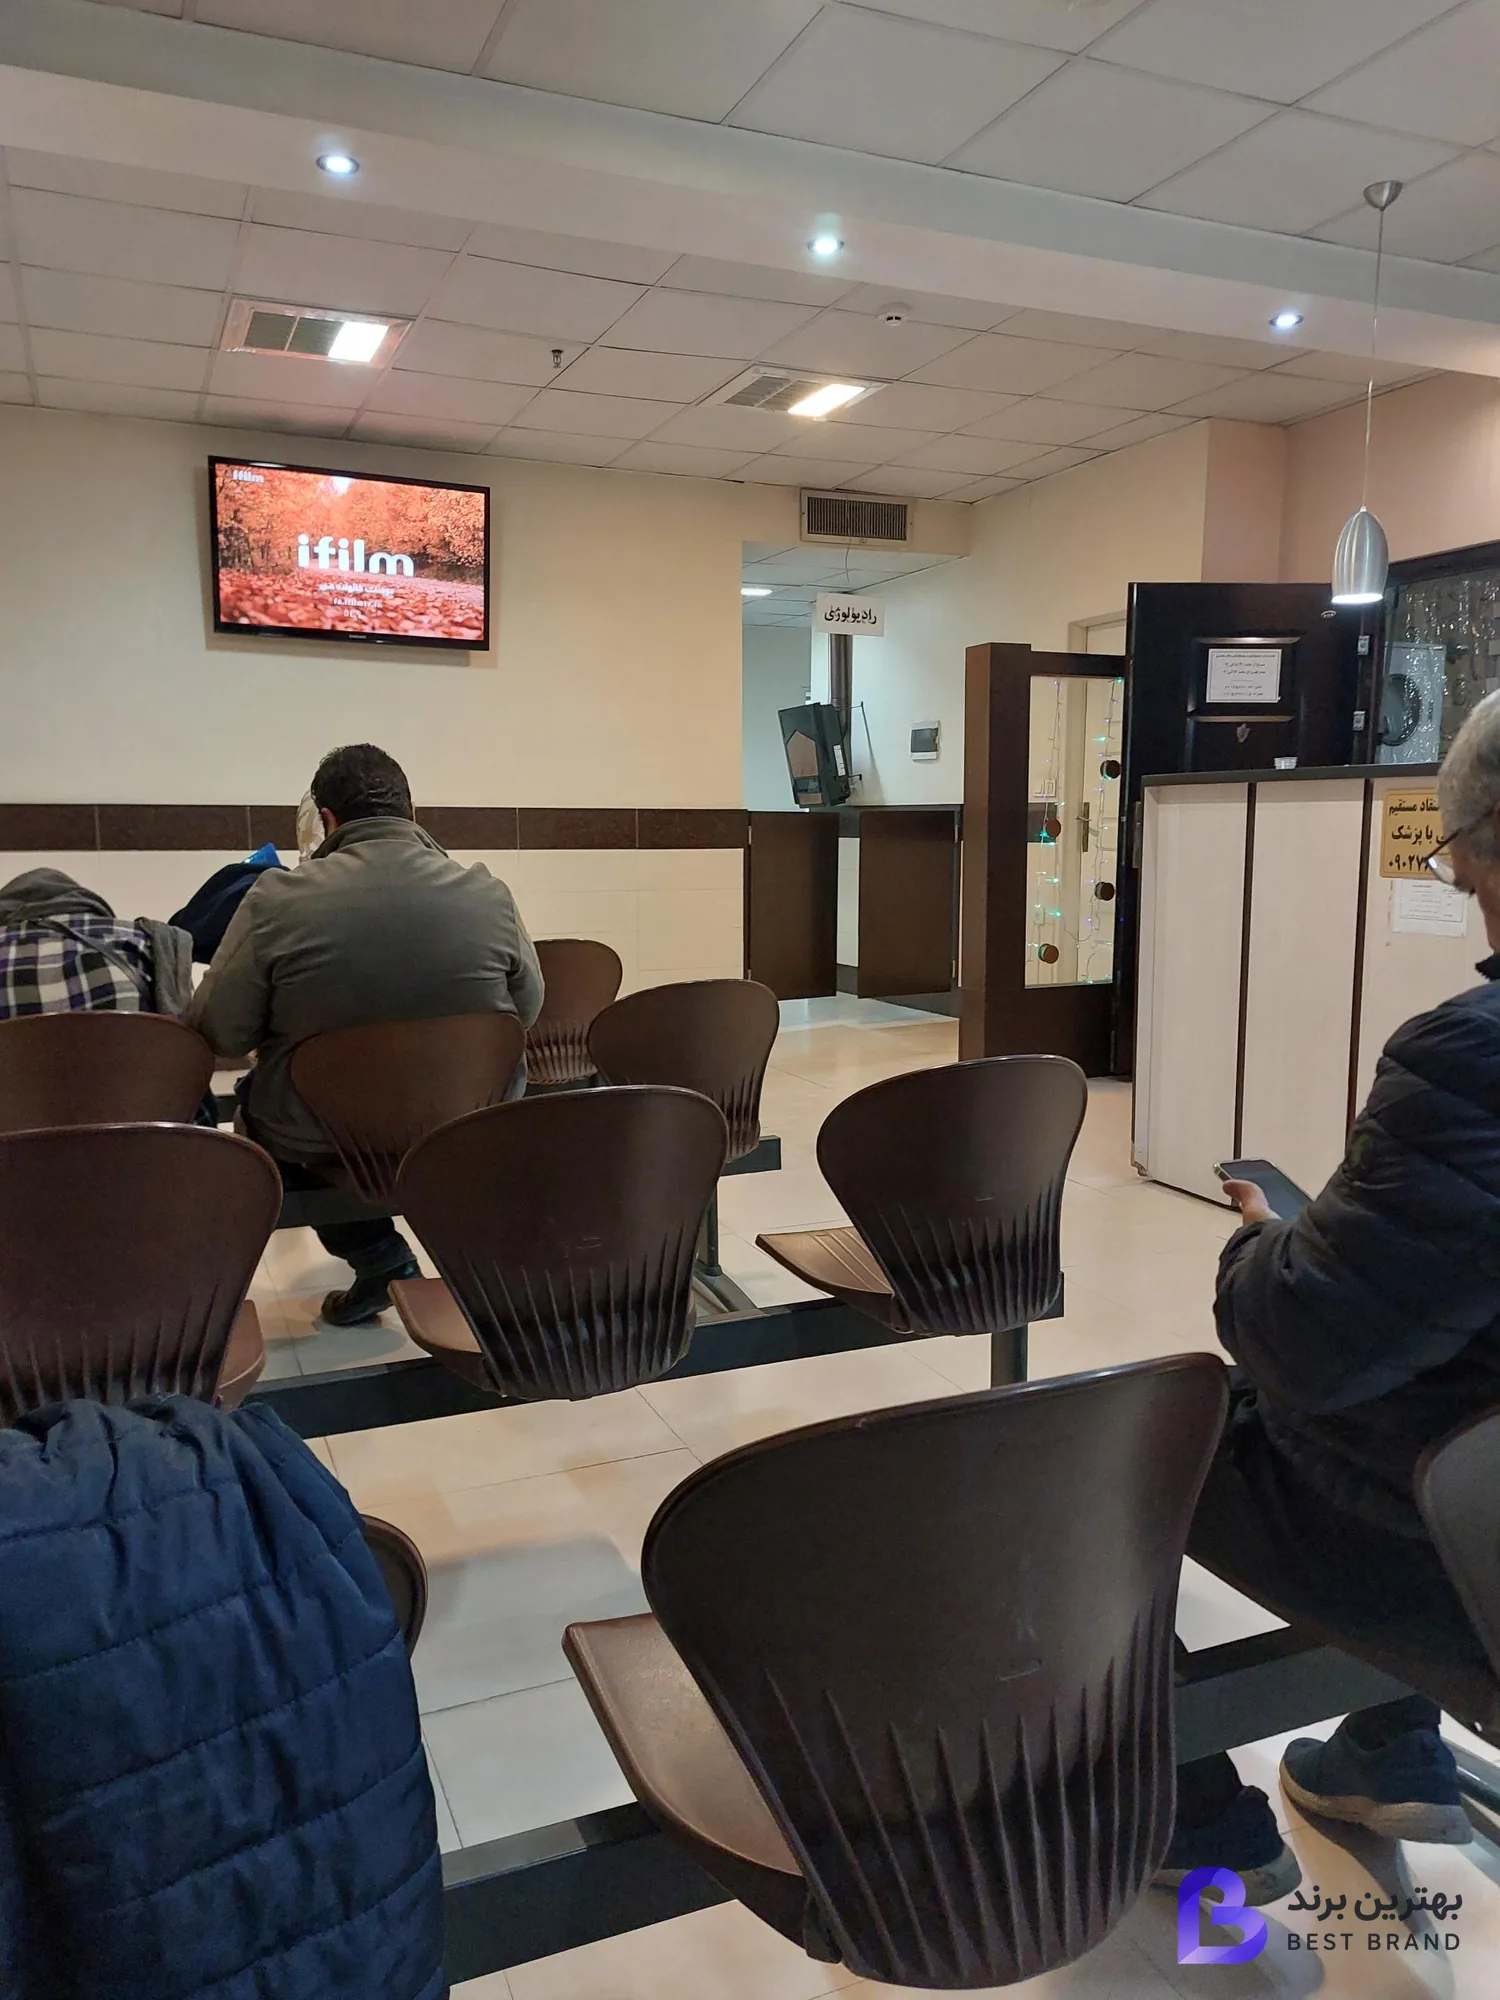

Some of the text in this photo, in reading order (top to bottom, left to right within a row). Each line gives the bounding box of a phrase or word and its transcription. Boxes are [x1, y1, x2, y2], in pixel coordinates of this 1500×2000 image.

[297, 533, 415, 577] ifilm
[824, 606, 877, 625] رادیولوژی
[1388, 798, 1418, 817] مستقیم
[1391, 824, 1423, 846] پزشک
[1425, 824, 1433, 844] با
[1388, 853, 1428, 873] ۰۹۰۲۷
